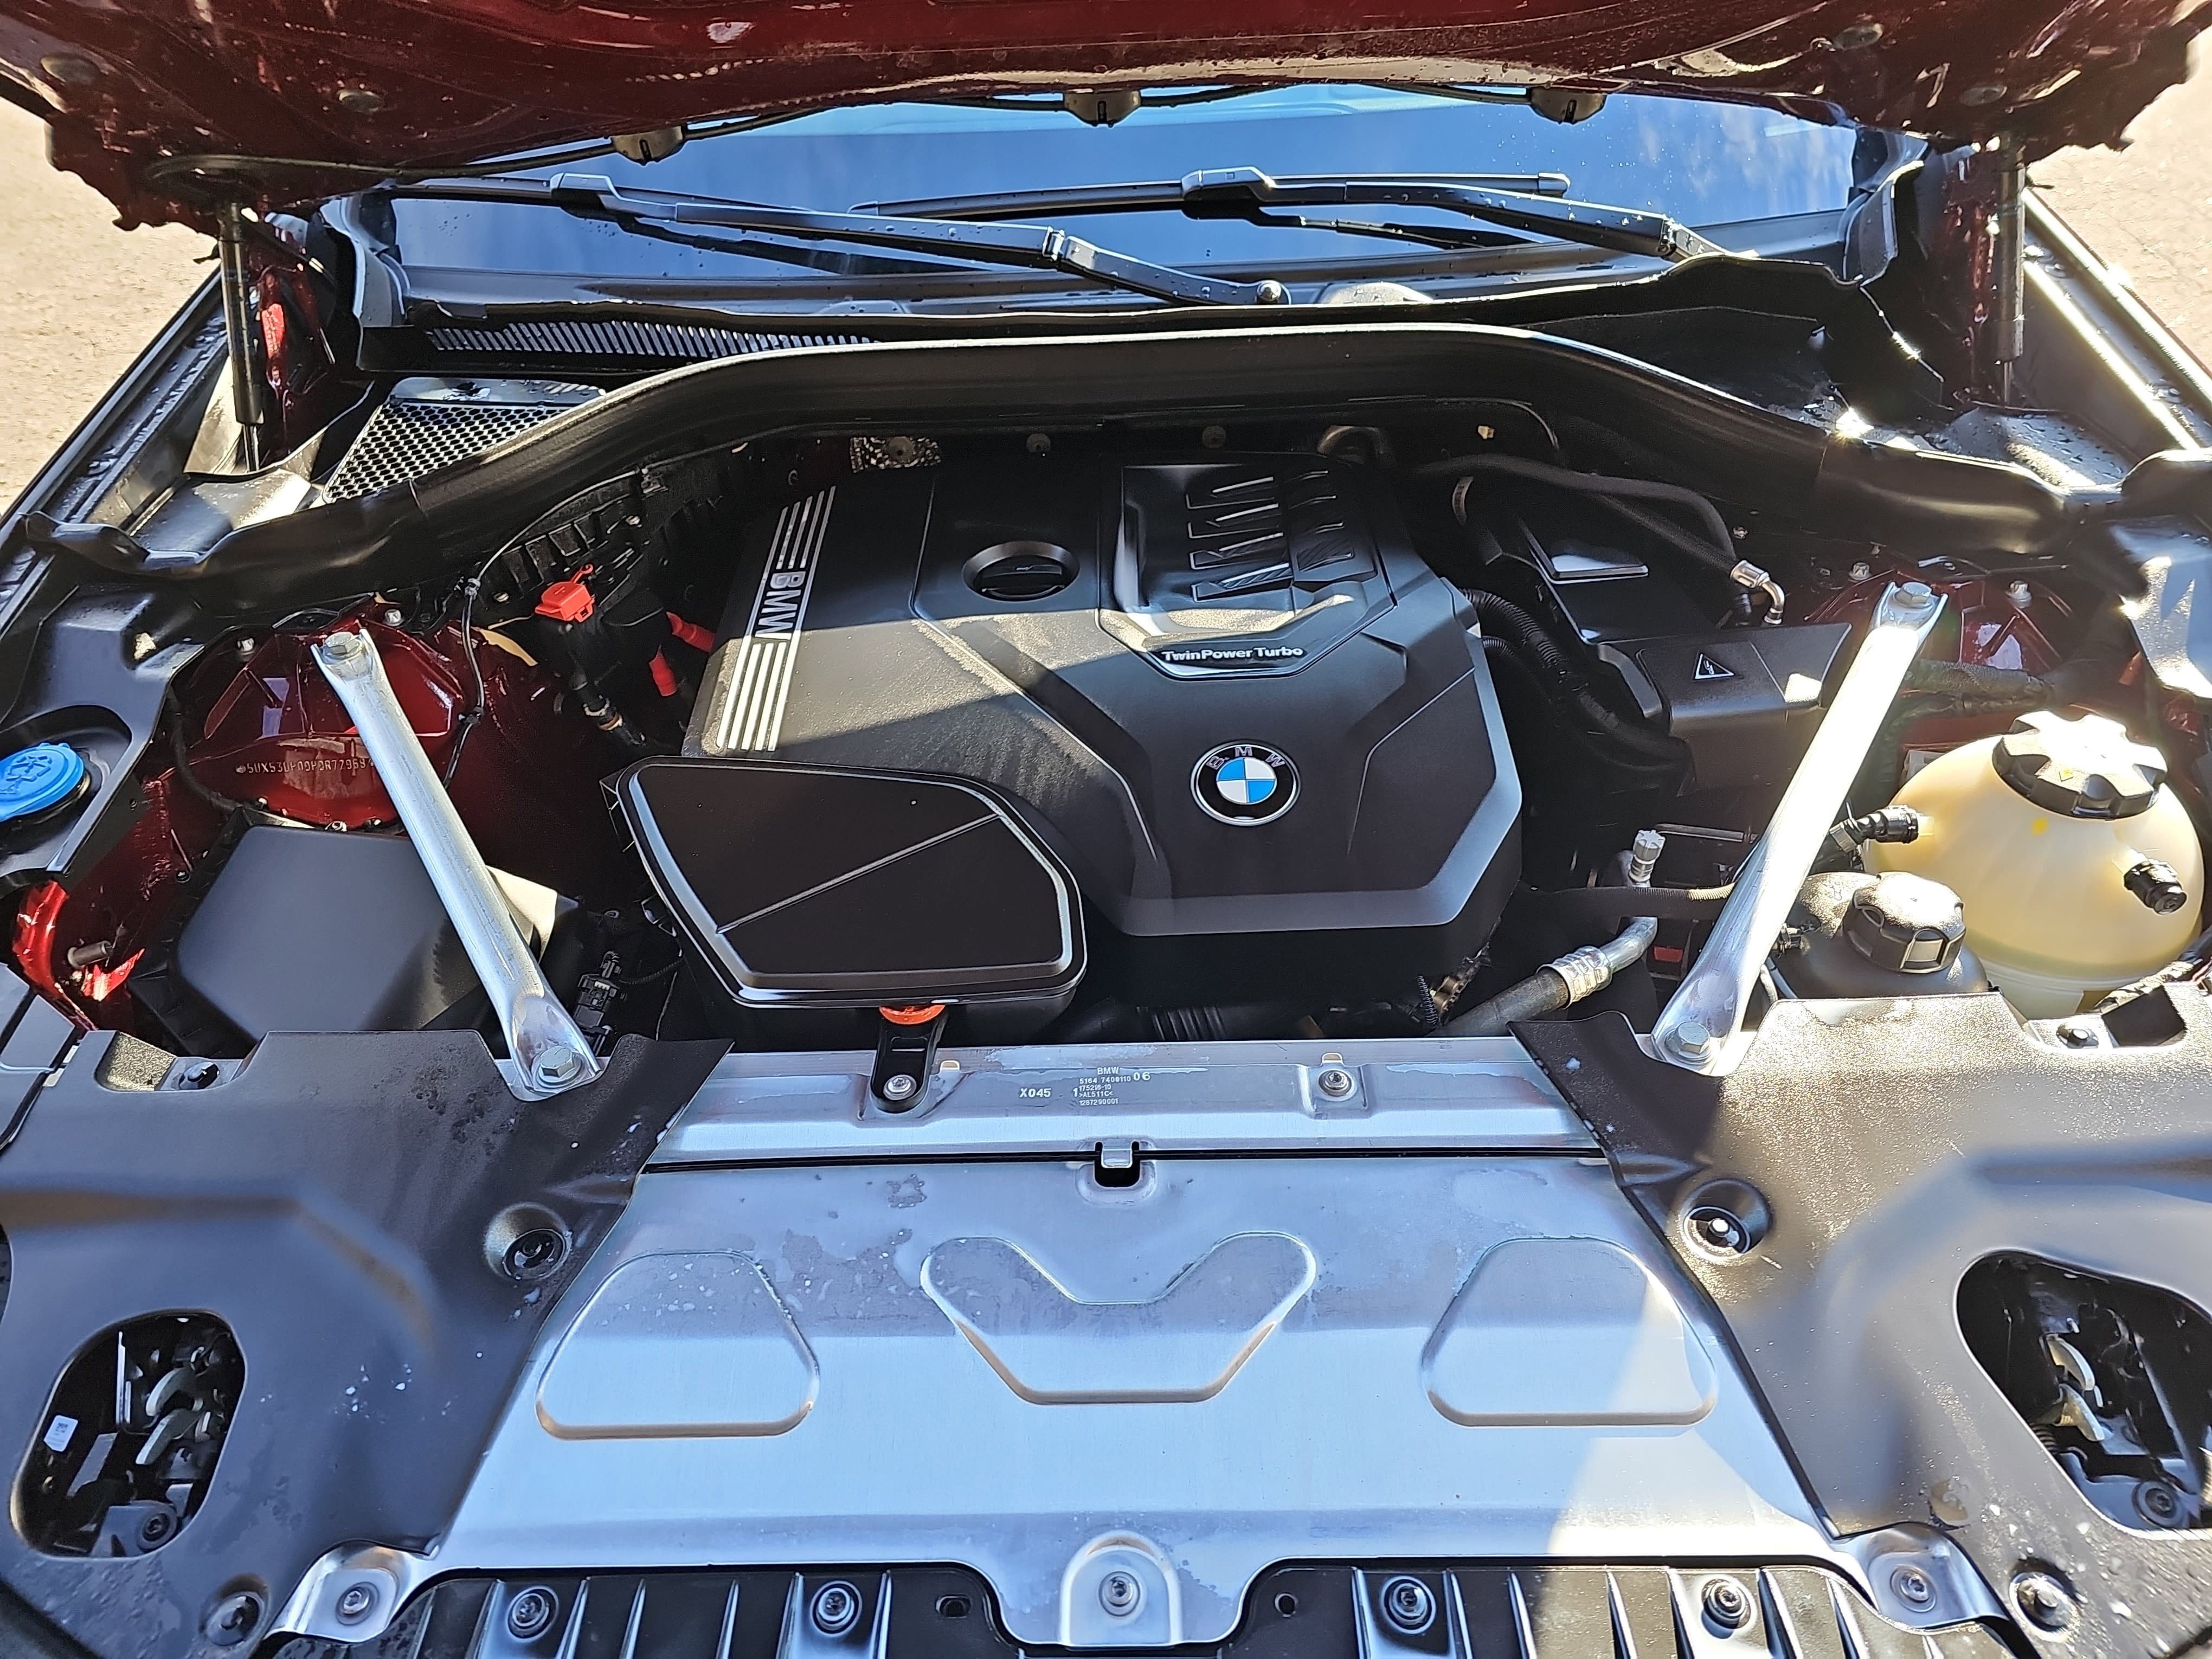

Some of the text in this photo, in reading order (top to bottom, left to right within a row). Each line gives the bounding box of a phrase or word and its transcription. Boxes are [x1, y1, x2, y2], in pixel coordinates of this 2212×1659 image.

[754, 571, 806, 640] BMW
[1161, 646, 1303, 661] TwinPower Turbo
[1206, 746, 1286, 770] BMW
[1097, 1066, 1120, 1075] BMW
[1133, 1071, 1150, 1081] 06
[1019, 1088, 1052, 1098] X045
